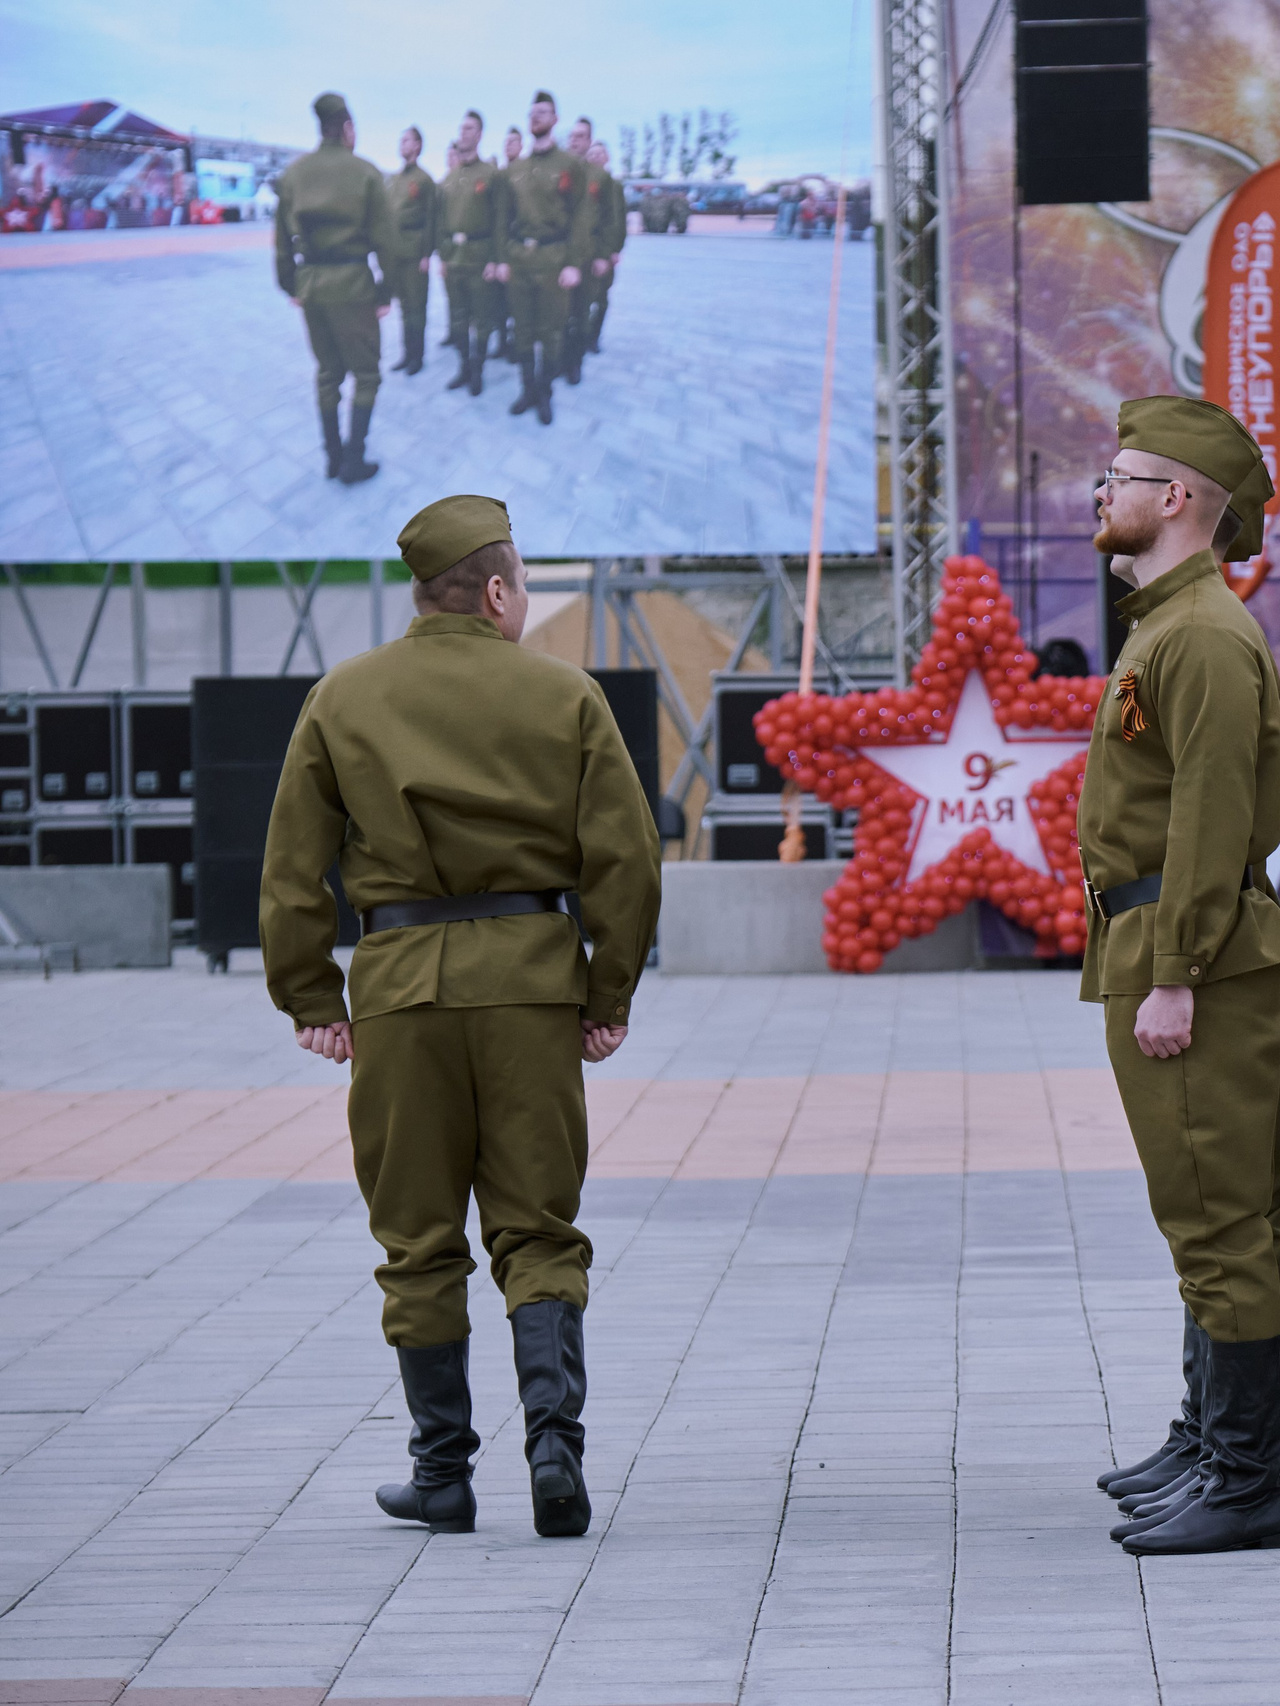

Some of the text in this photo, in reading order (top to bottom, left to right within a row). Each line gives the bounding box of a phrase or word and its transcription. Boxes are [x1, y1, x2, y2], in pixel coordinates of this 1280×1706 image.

[1228, 222, 1251, 426] НОВИЧСКОЕ ОАО
[1247, 211, 1277, 492] ГНЕУПОРЫ»
[939, 797, 1015, 824] МАЯ
[963, 752, 993, 791] 9
